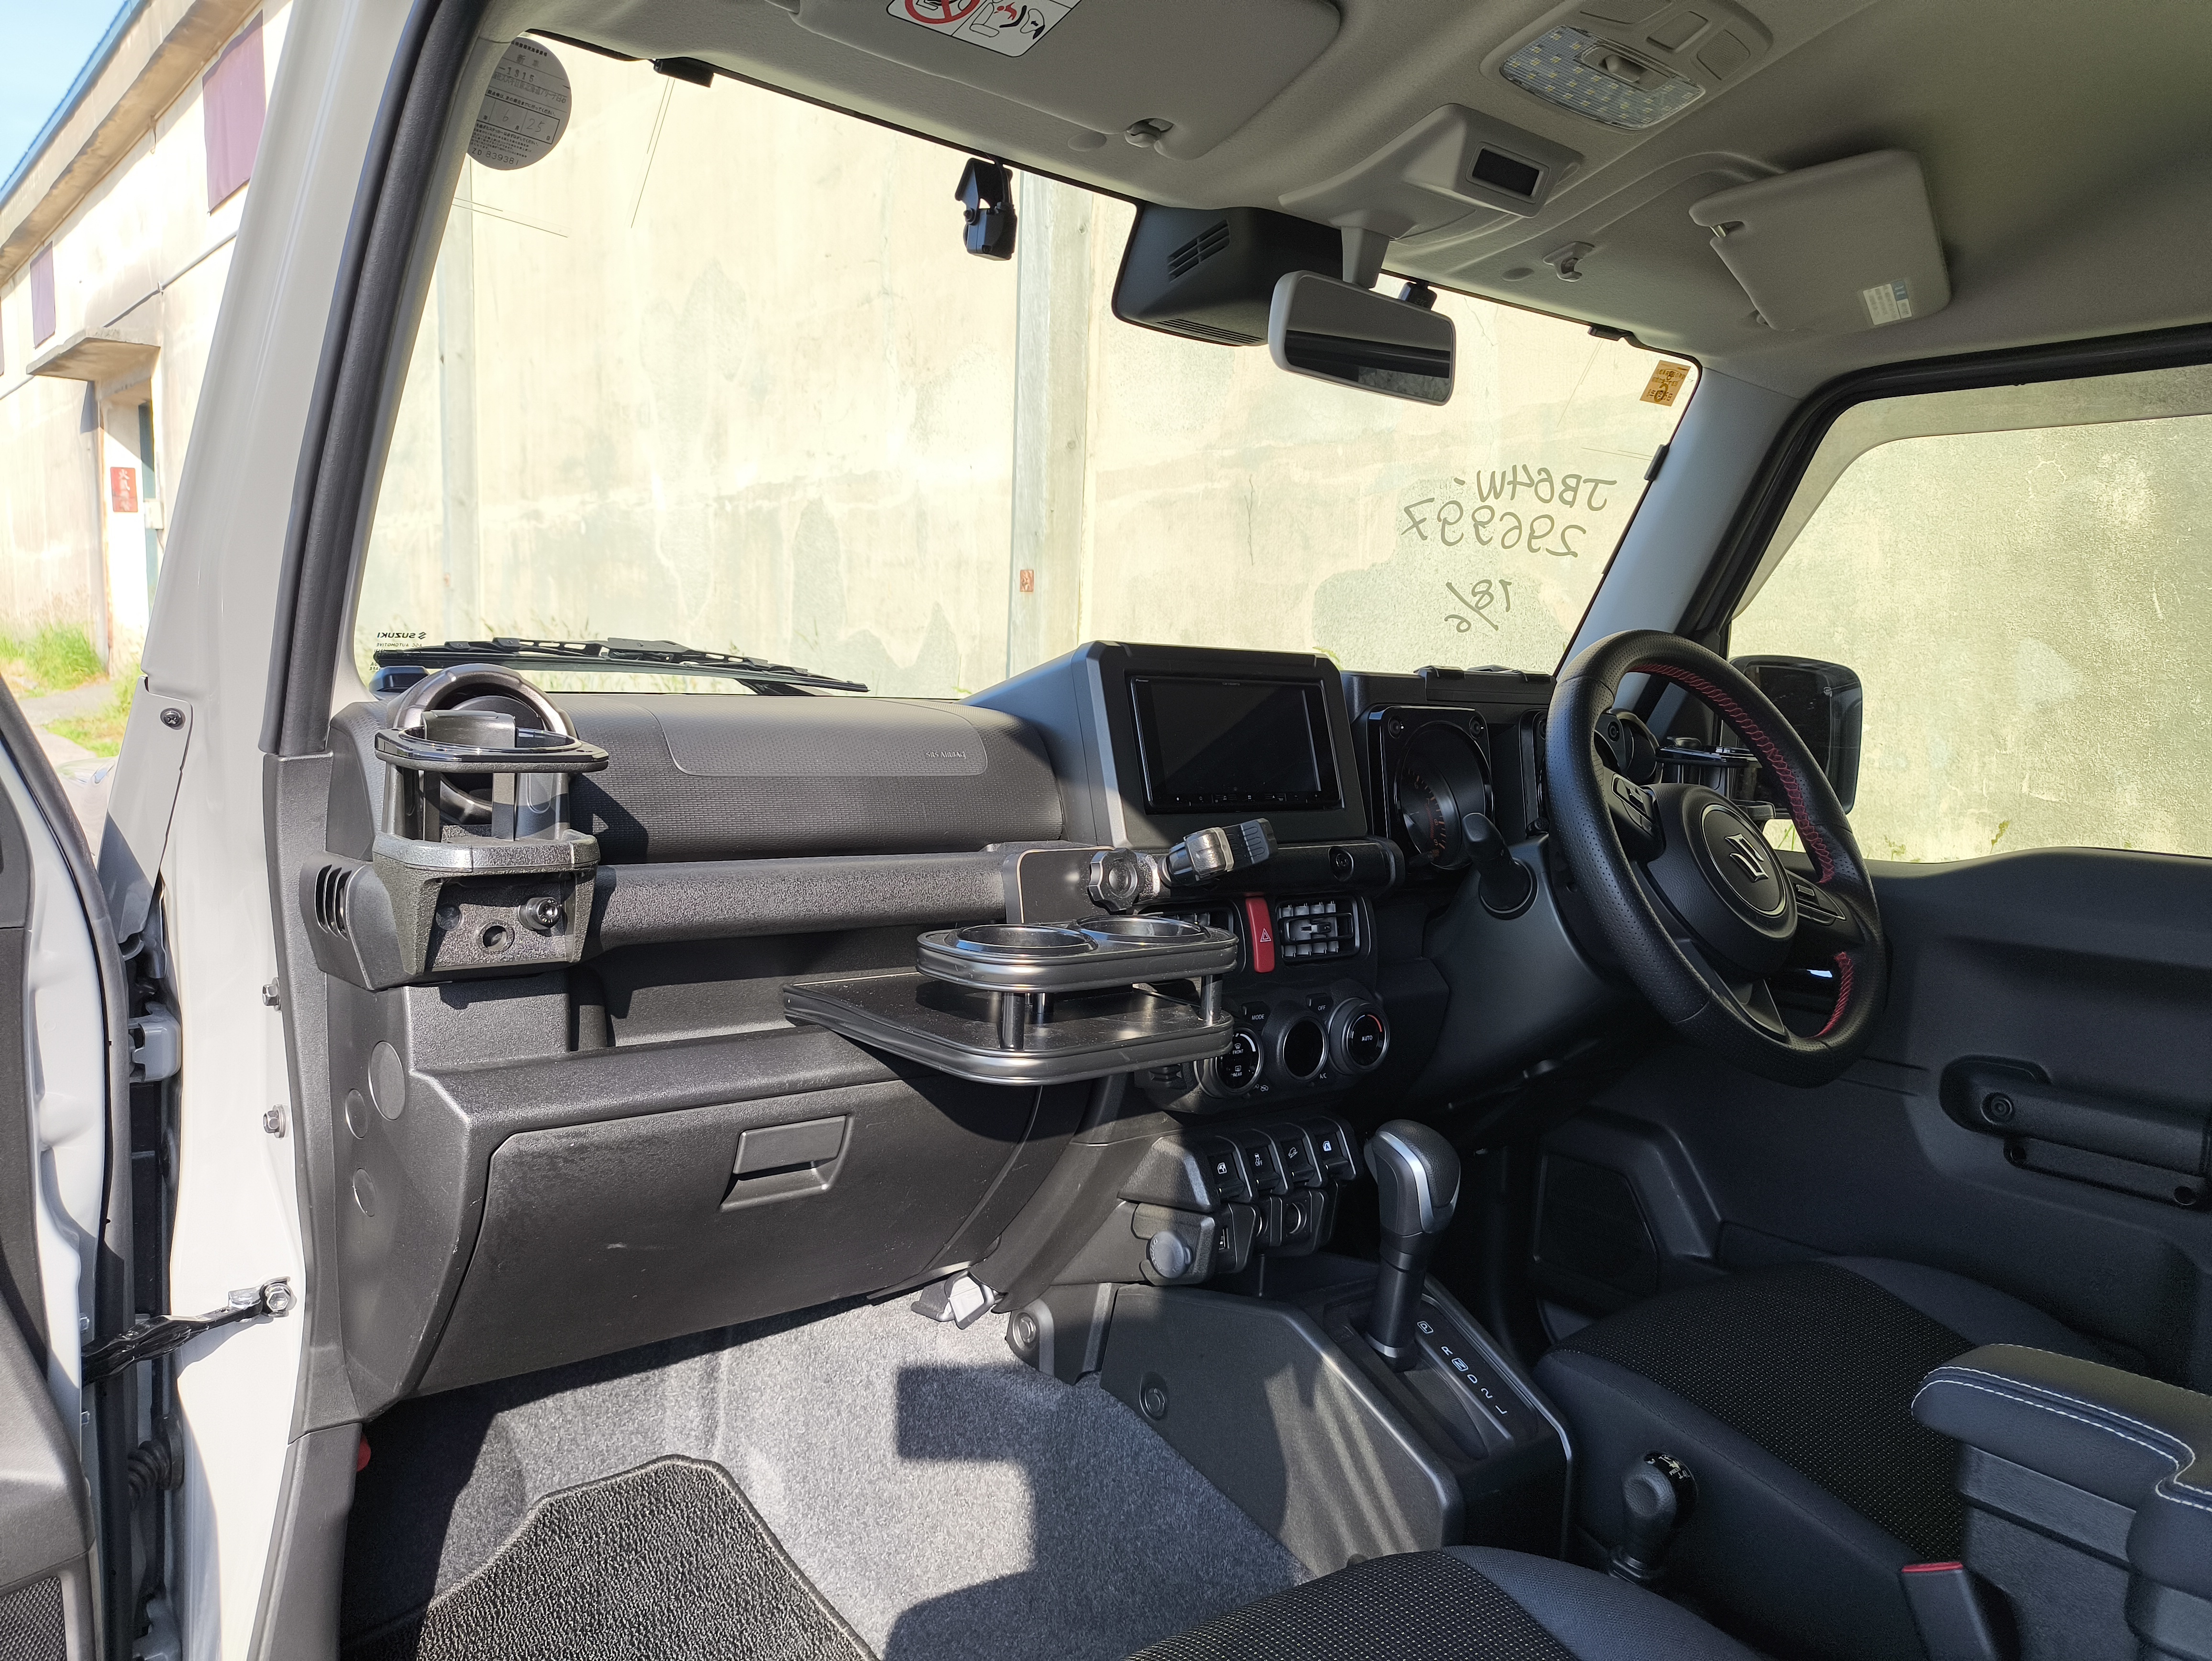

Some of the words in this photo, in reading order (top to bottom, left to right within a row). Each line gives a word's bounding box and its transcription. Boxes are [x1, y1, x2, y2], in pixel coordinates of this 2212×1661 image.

[502, 108, 509, 122] 6
[526, 118, 546, 133] 25
[472, 147, 482, 156] ZD
[485, 150, 519, 166] 839381
[940, 751, 966, 759] AIRBAG
[1441, 1346, 1453, 1356] R
[1467, 1374, 1478, 1384] D
[1481, 1388, 1493, 1399] 2
[1495, 1405, 1508, 1415] L
